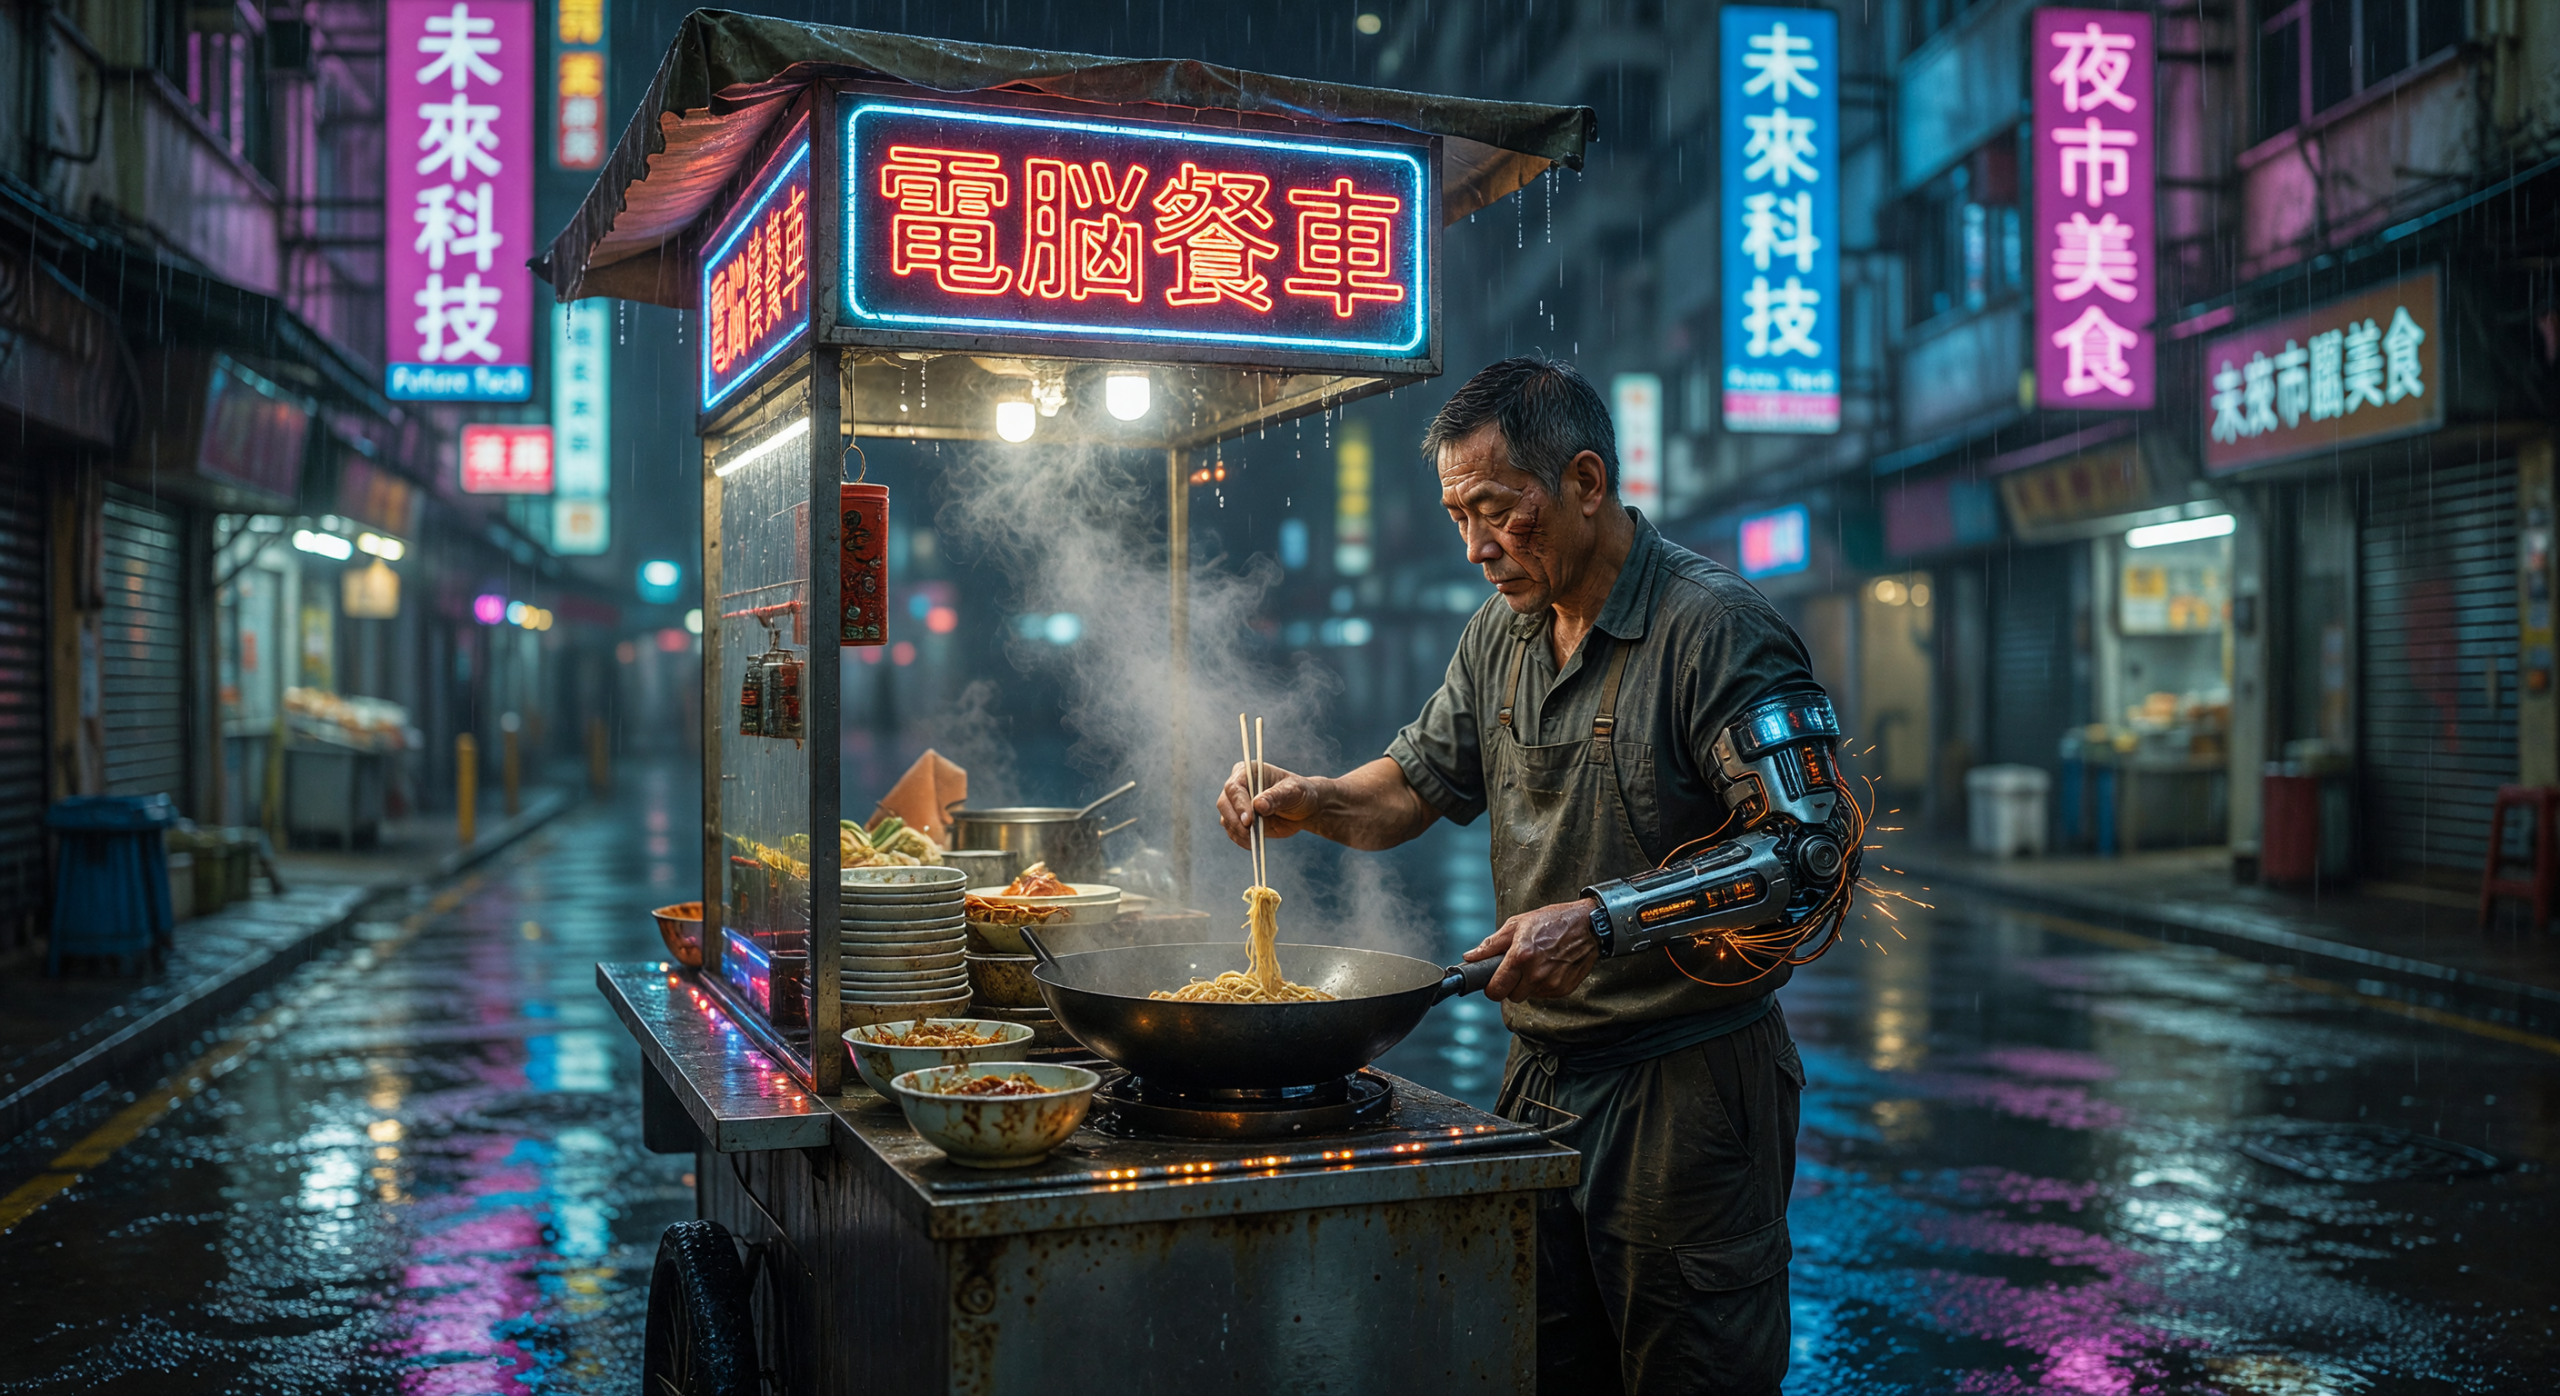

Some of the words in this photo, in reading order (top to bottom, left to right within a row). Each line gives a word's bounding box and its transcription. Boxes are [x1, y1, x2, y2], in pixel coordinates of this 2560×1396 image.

[414, 3, 503, 363] 未來科技
[1742, 22, 1821, 358] 未來科技
[2049, 22, 2138, 398] 夜市美食
